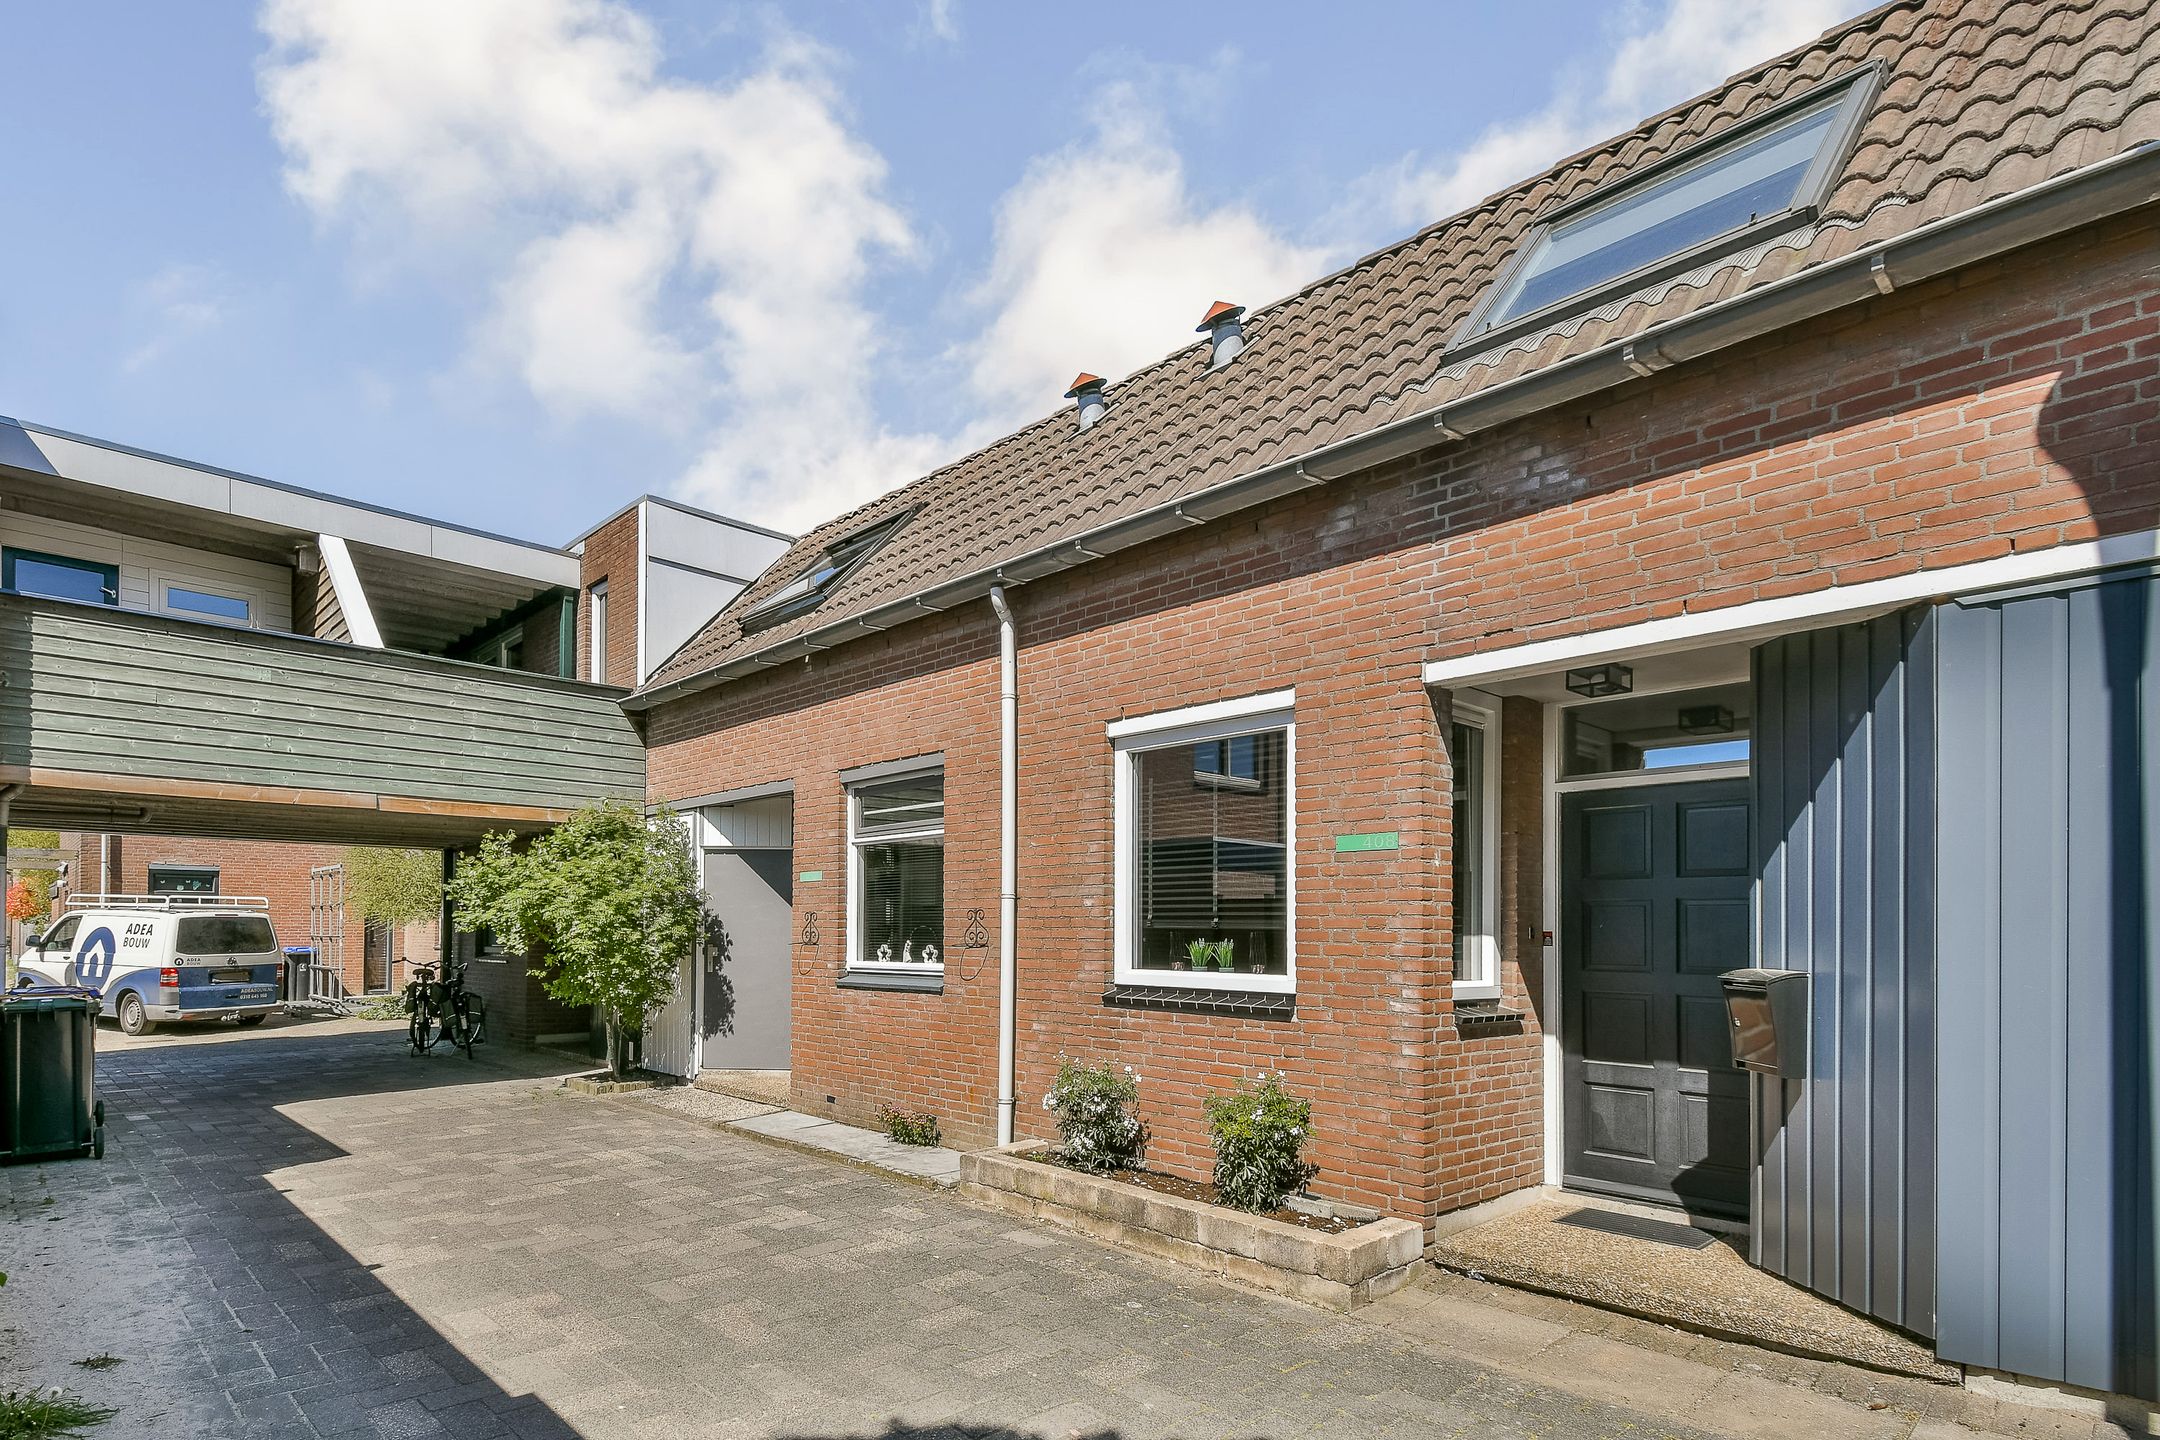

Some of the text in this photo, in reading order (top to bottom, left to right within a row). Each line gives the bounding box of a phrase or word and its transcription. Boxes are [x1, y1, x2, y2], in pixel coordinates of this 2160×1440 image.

[1362, 834, 1395, 848] 408
[125, 923, 153, 936] ADEA
[123, 937, 151, 948] BOUW
